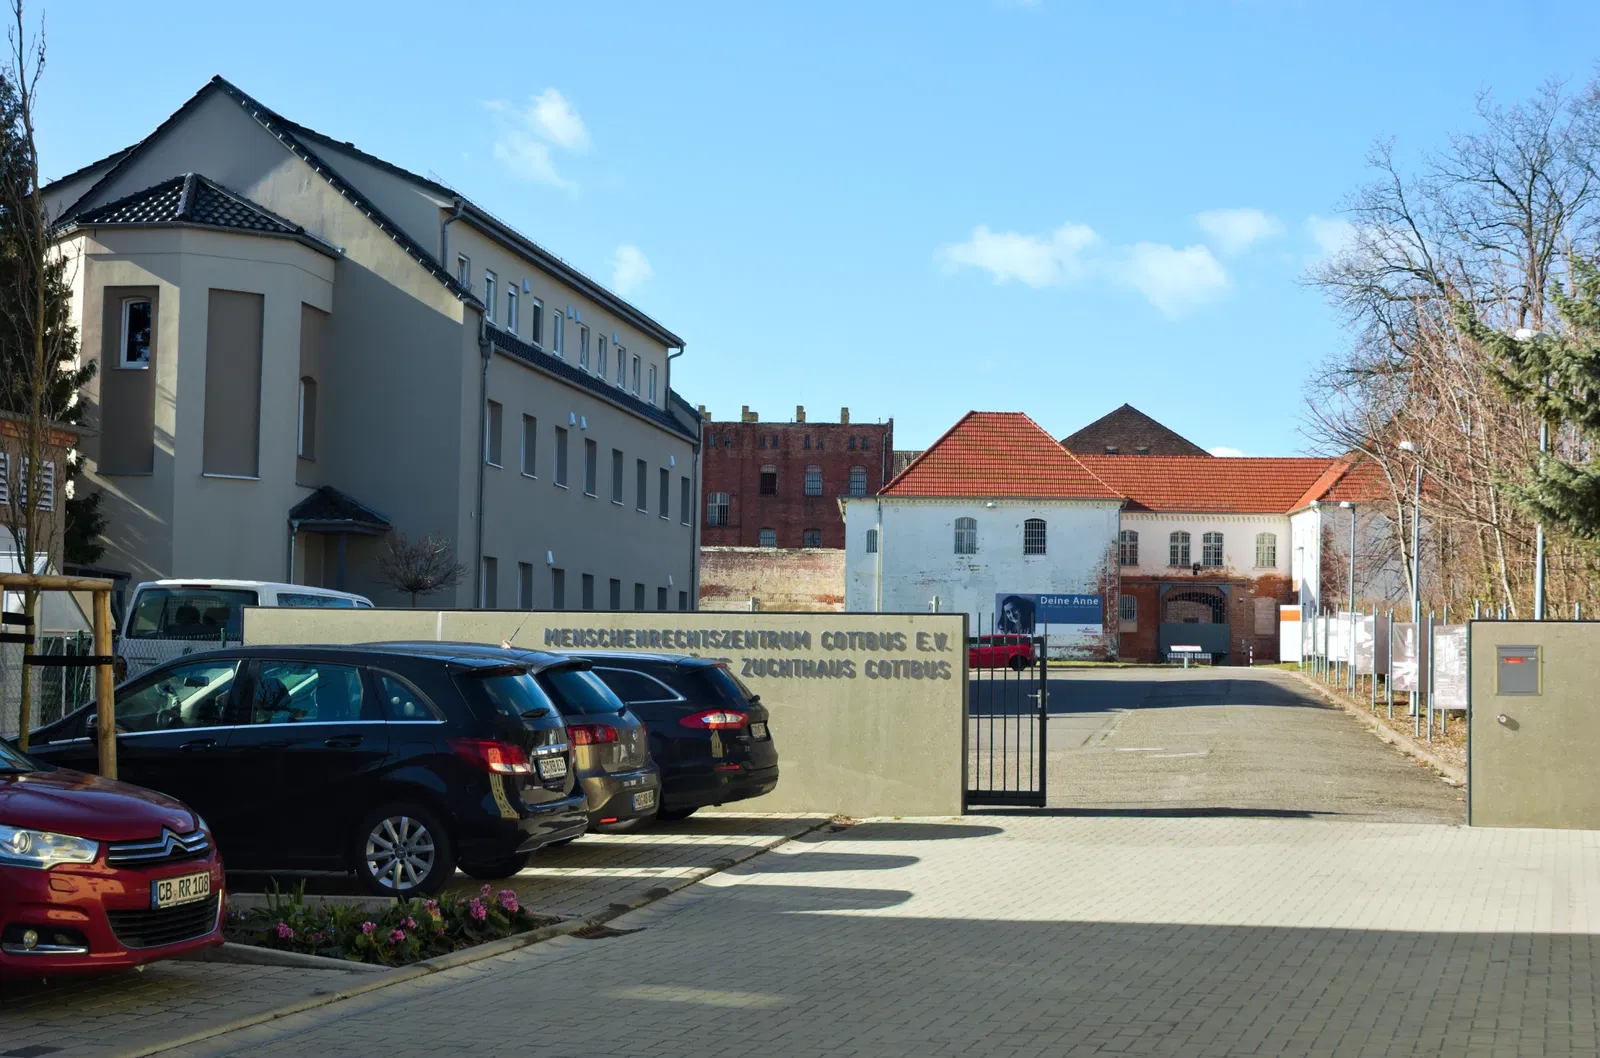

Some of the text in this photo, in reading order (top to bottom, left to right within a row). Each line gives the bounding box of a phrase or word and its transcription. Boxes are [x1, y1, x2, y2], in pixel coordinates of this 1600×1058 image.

[1040, 596, 1099, 605] Deine Anne
[544, 628, 811, 650] MENSCHENRECHTSZENTRUM
[820, 630, 907, 651] COTTBUS
[741, 657, 857, 679] ZUCHTHAUS
[865, 659, 951, 680] COTTBUS
